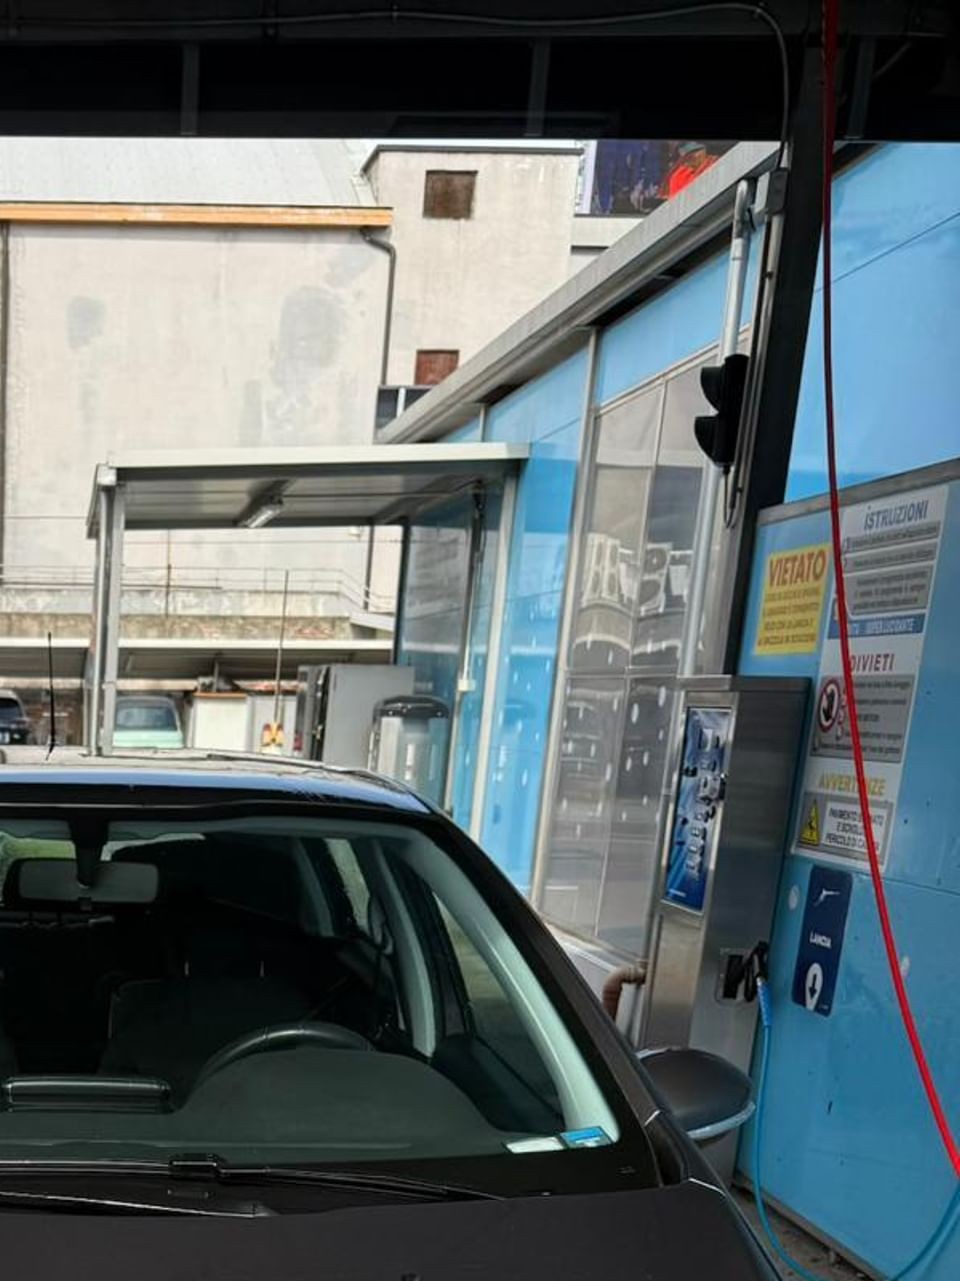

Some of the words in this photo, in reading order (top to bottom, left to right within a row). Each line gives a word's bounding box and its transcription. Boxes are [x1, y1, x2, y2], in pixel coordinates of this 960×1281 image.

[769, 550, 827, 587] VIETATO
[849, 653, 895, 673] DIVIETI
[809, 931, 832, 950] LANCIA
